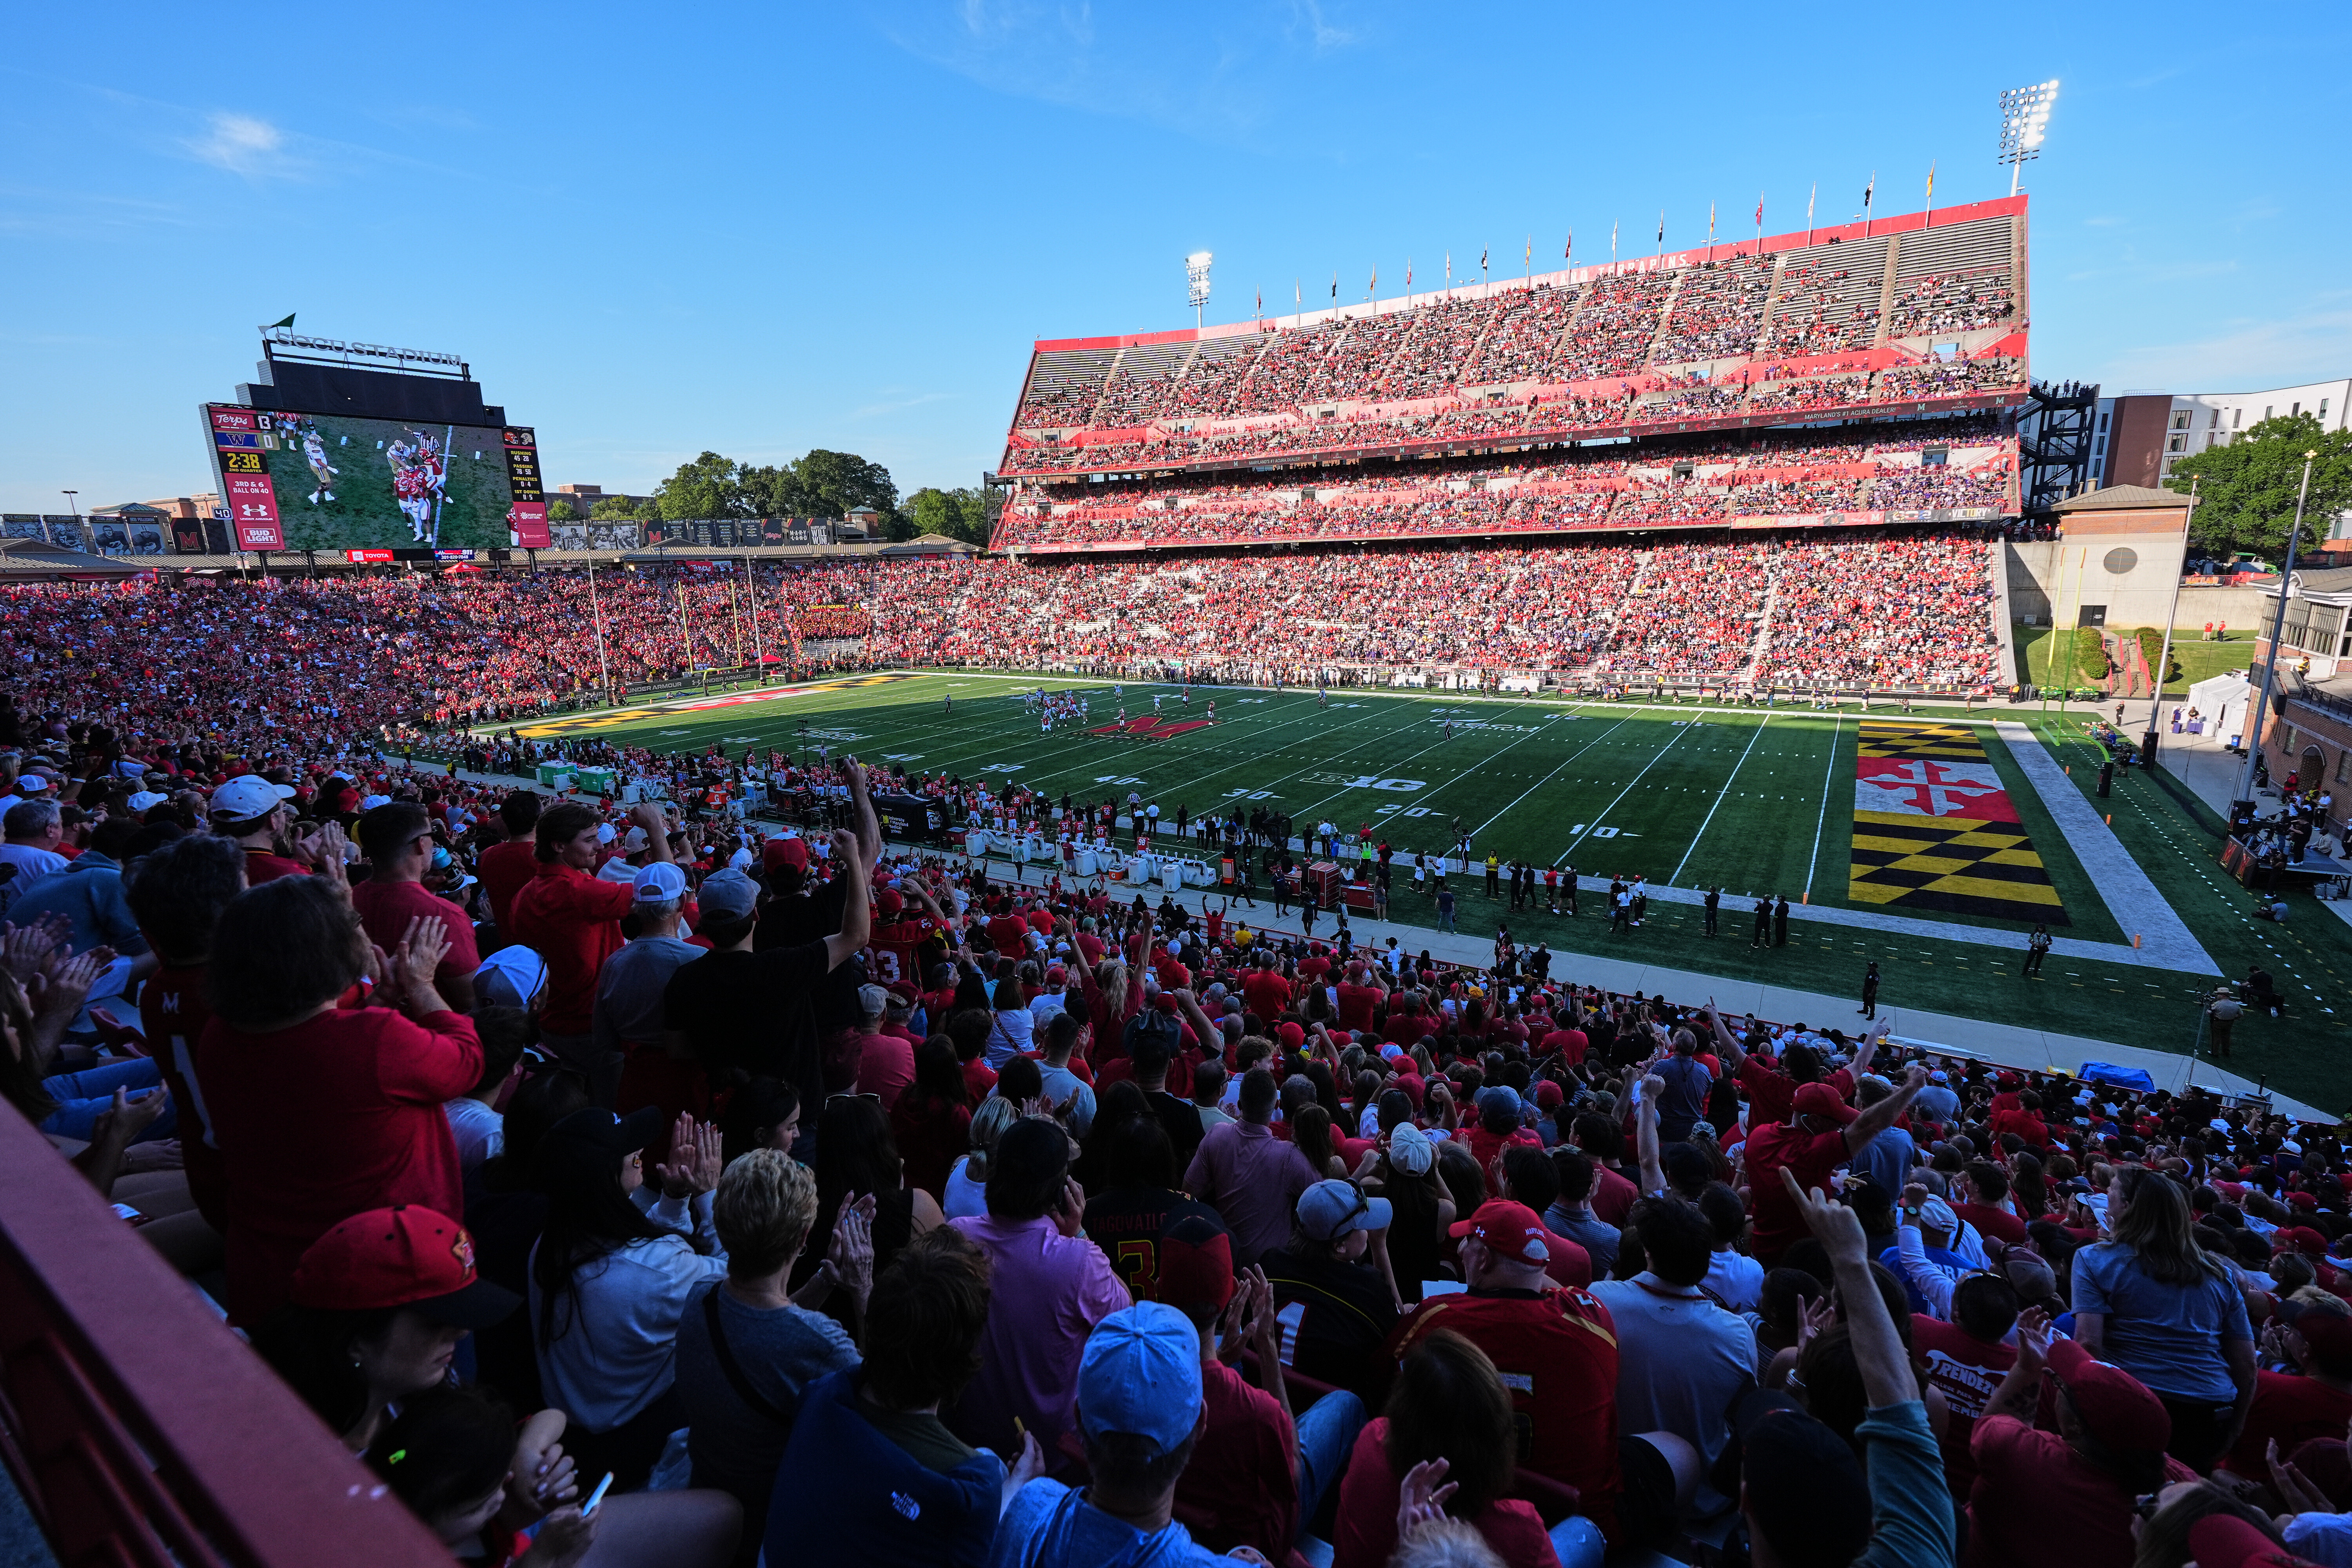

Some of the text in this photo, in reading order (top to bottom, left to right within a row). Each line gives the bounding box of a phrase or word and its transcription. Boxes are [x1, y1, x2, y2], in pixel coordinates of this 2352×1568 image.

[216, 414, 247, 426] Terps
[258, 416, 271, 429] 13
[227, 434, 245, 445] W
[263, 435, 273, 448] 0
[227, 453, 260, 469] 2:38
[215, 509, 230, 518] 40
[1871, 513, 1880, 521] M
[1952, 508, 1986, 518] VICTORY
[1735, 518, 1747, 527] PAY
[1778, 516, 1799, 526] SCORE
[1800, 516, 1819, 525] MORE
[1831, 516, 1839, 524] M
[177, 532, 201, 548] M
[648, 531, 662, 543] M
[652, 682, 682, 690] ARMOUR
[1777, 679, 1855, 688] MARYLAND
[980, 763, 1026, 772] 50
[1093, 775, 1140, 785] 40
[1221, 789, 1274, 800] 30
[1375, 804, 1431, 817] 20
[1569, 824, 1620, 838] 10
[1138, 838, 1146, 847] 98
[921, 918, 933, 928] 33
[865, 946, 900, 985] 33
[162, 992, 180, 1014] M
[999, 1024, 1011, 1040] TERPS
[1118, 1239, 1157, 1301] 3
[1275, 1299, 1308, 1367] 1
[1936, 1361, 1996, 1396] RENDEZ
